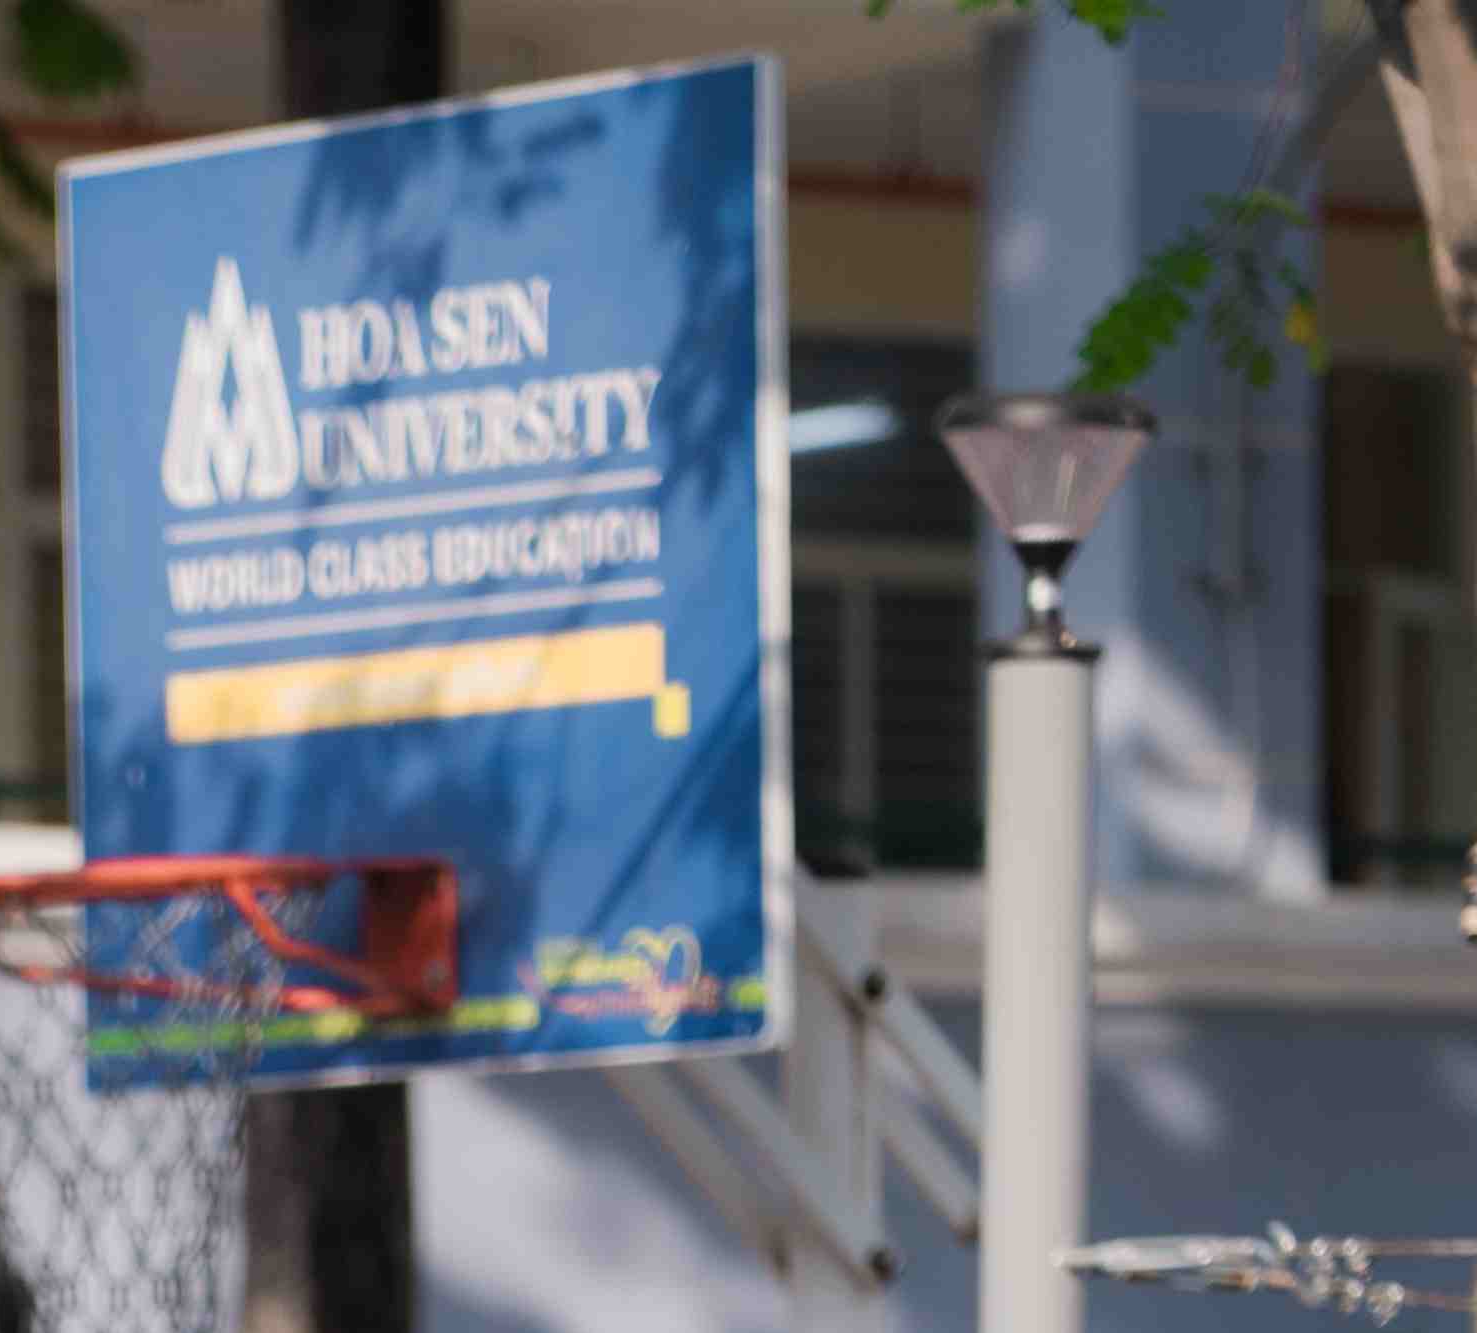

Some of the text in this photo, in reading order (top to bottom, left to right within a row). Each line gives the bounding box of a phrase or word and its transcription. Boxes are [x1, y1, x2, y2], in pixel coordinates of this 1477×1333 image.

[299, 275, 550, 390] HOA SEN
[299, 365, 662, 488] UNIVERSITY
[168, 508, 661, 614] WORLD CLASS EDUCATION
